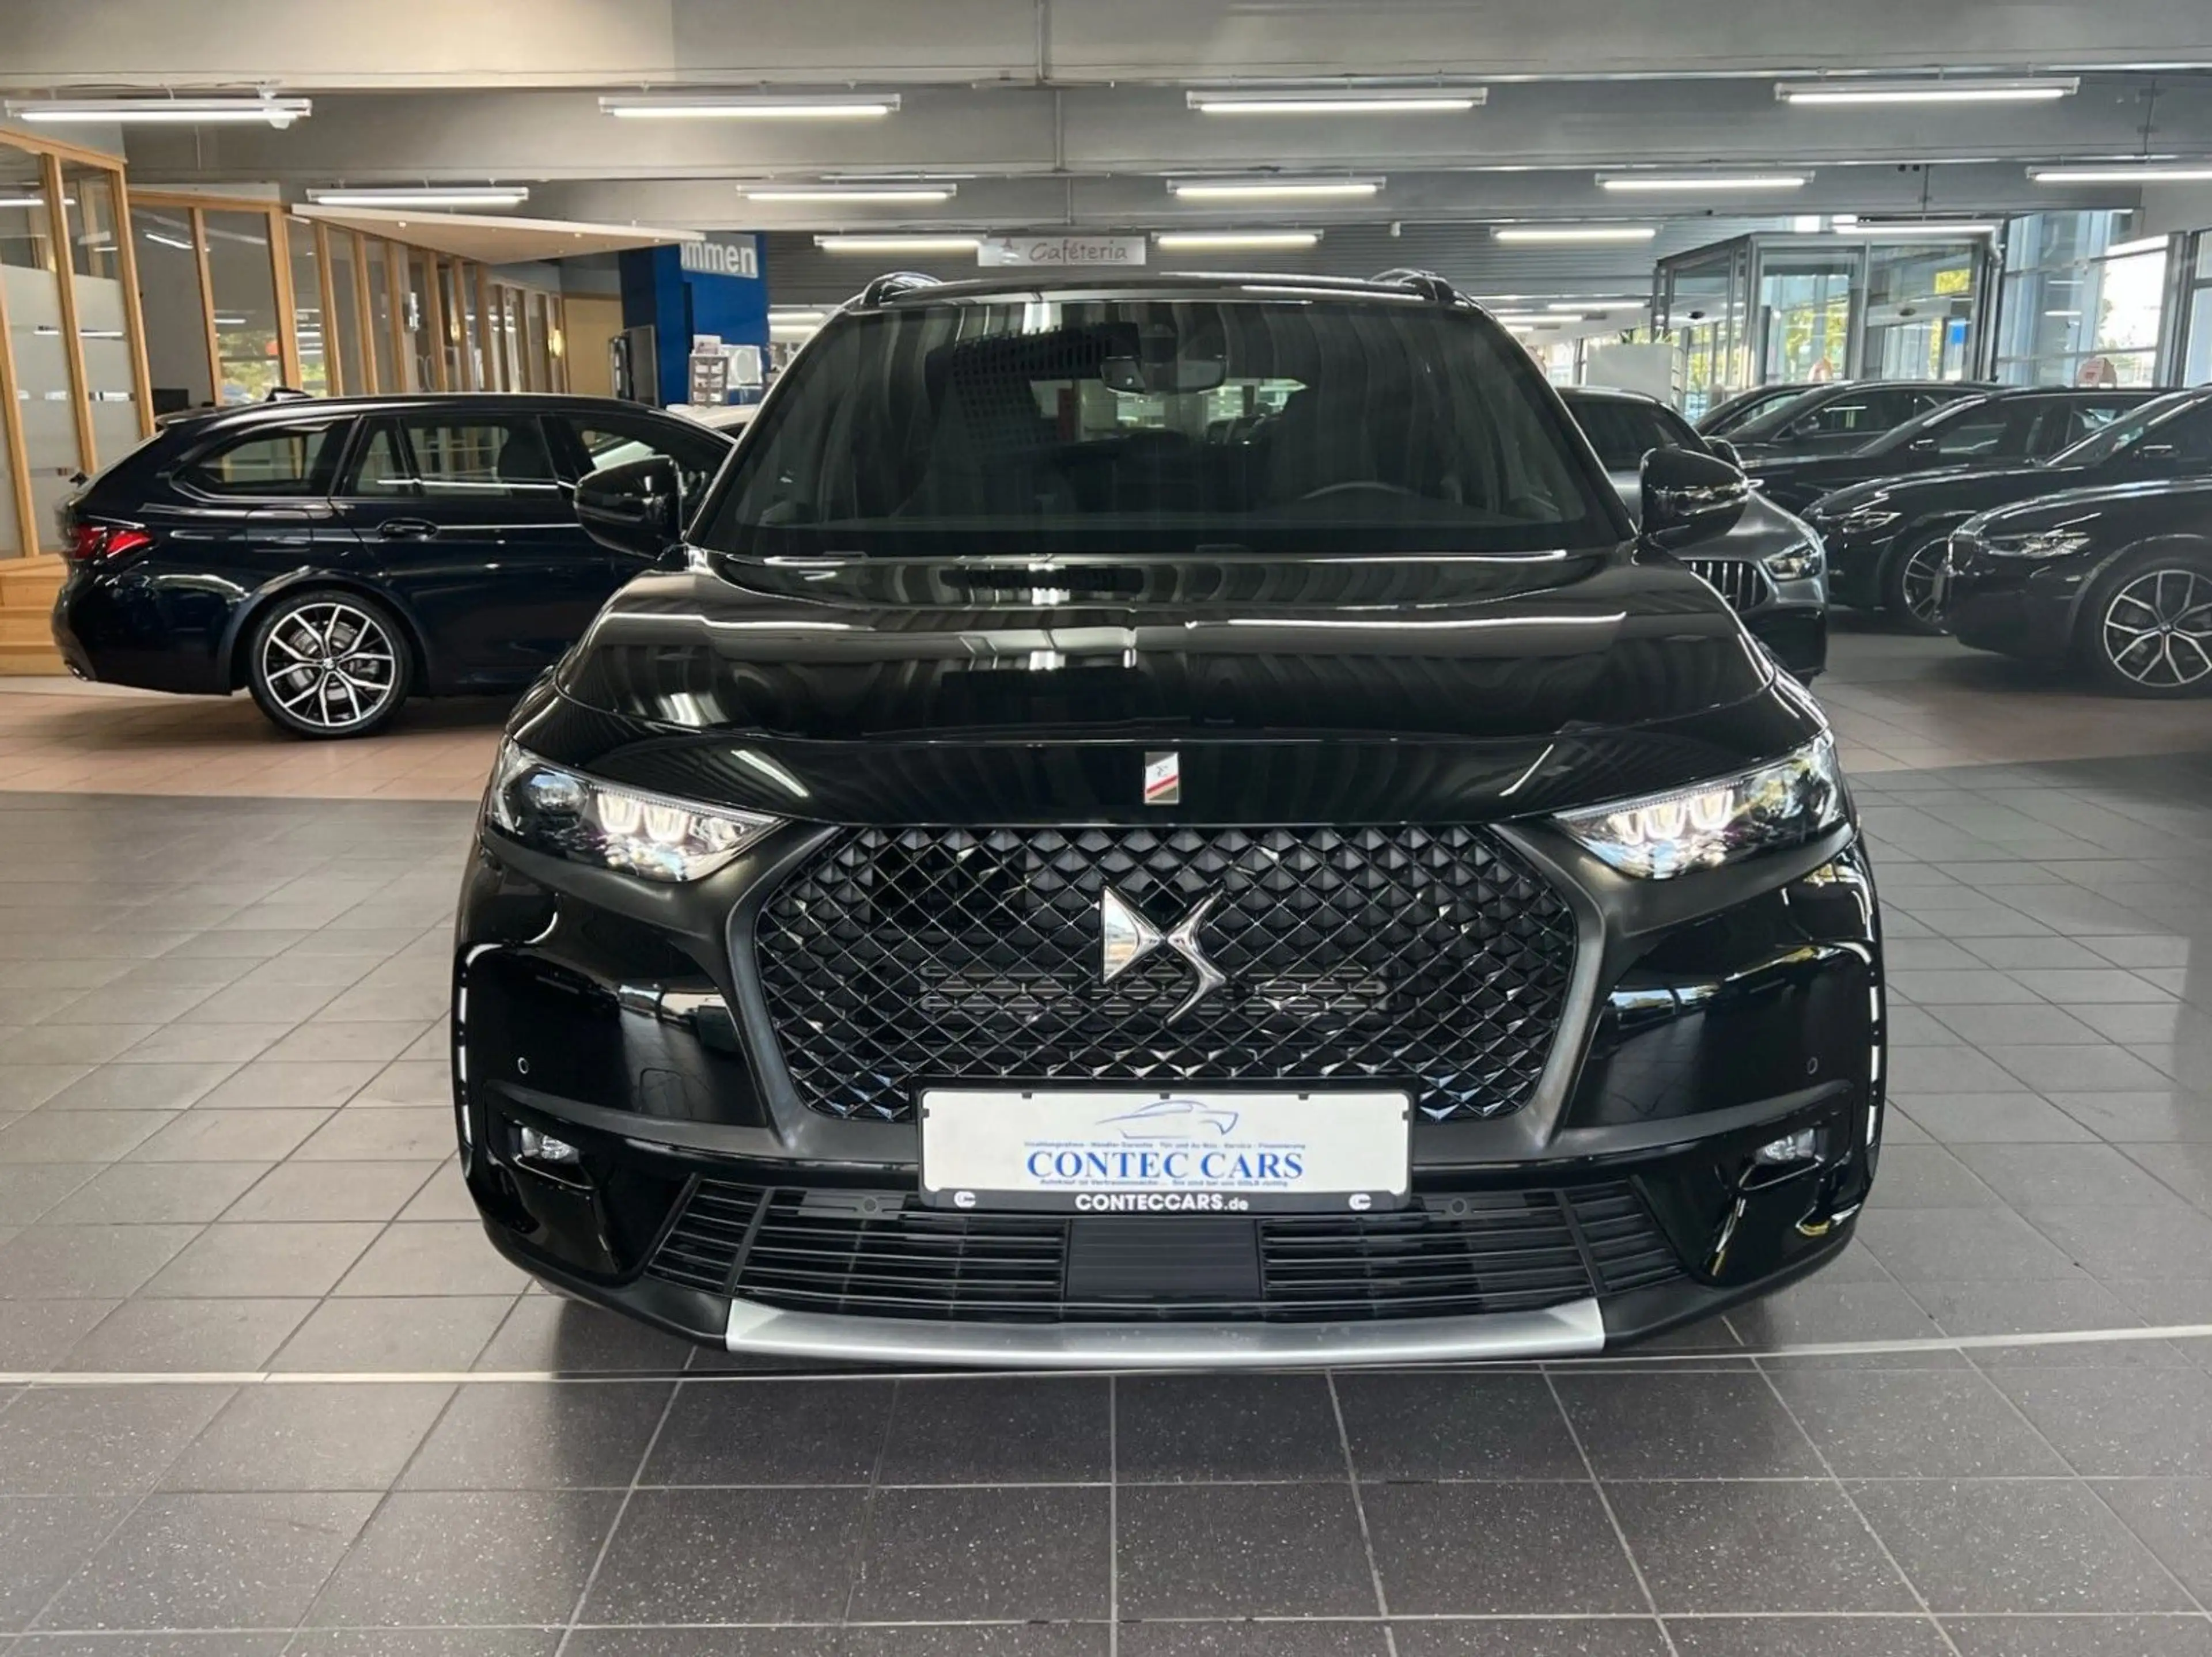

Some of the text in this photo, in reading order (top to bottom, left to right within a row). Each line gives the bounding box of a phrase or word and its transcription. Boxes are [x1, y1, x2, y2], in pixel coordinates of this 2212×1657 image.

[1027, 1150, 1304, 1180] CONTEC CARS
[1075, 1193, 1249, 1211] CONTECCARS.de
